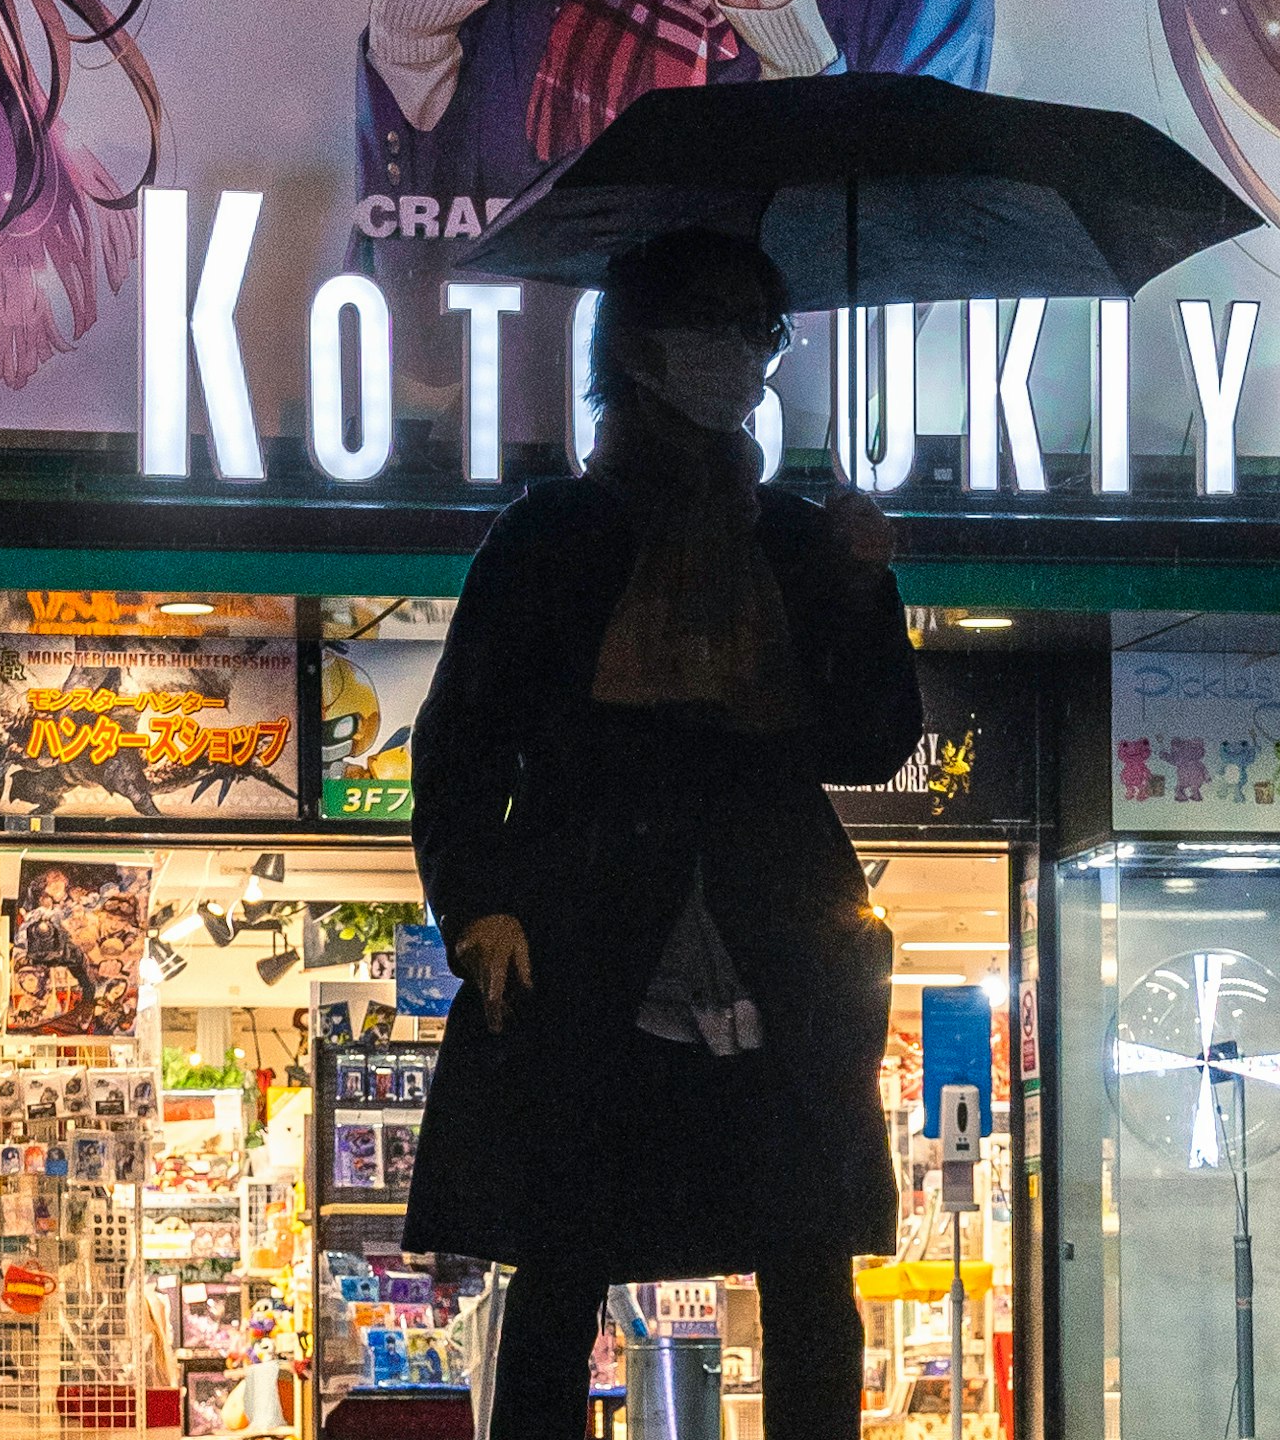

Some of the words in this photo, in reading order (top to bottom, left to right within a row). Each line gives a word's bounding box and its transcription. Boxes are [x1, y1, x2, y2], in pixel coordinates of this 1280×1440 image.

[26, 650, 103, 668] MONSTER
[107, 651, 166, 669] HUNTER
[26, 688, 227, 713] モンスターハンター
[25, 715, 292, 767] ハンターズショップ
